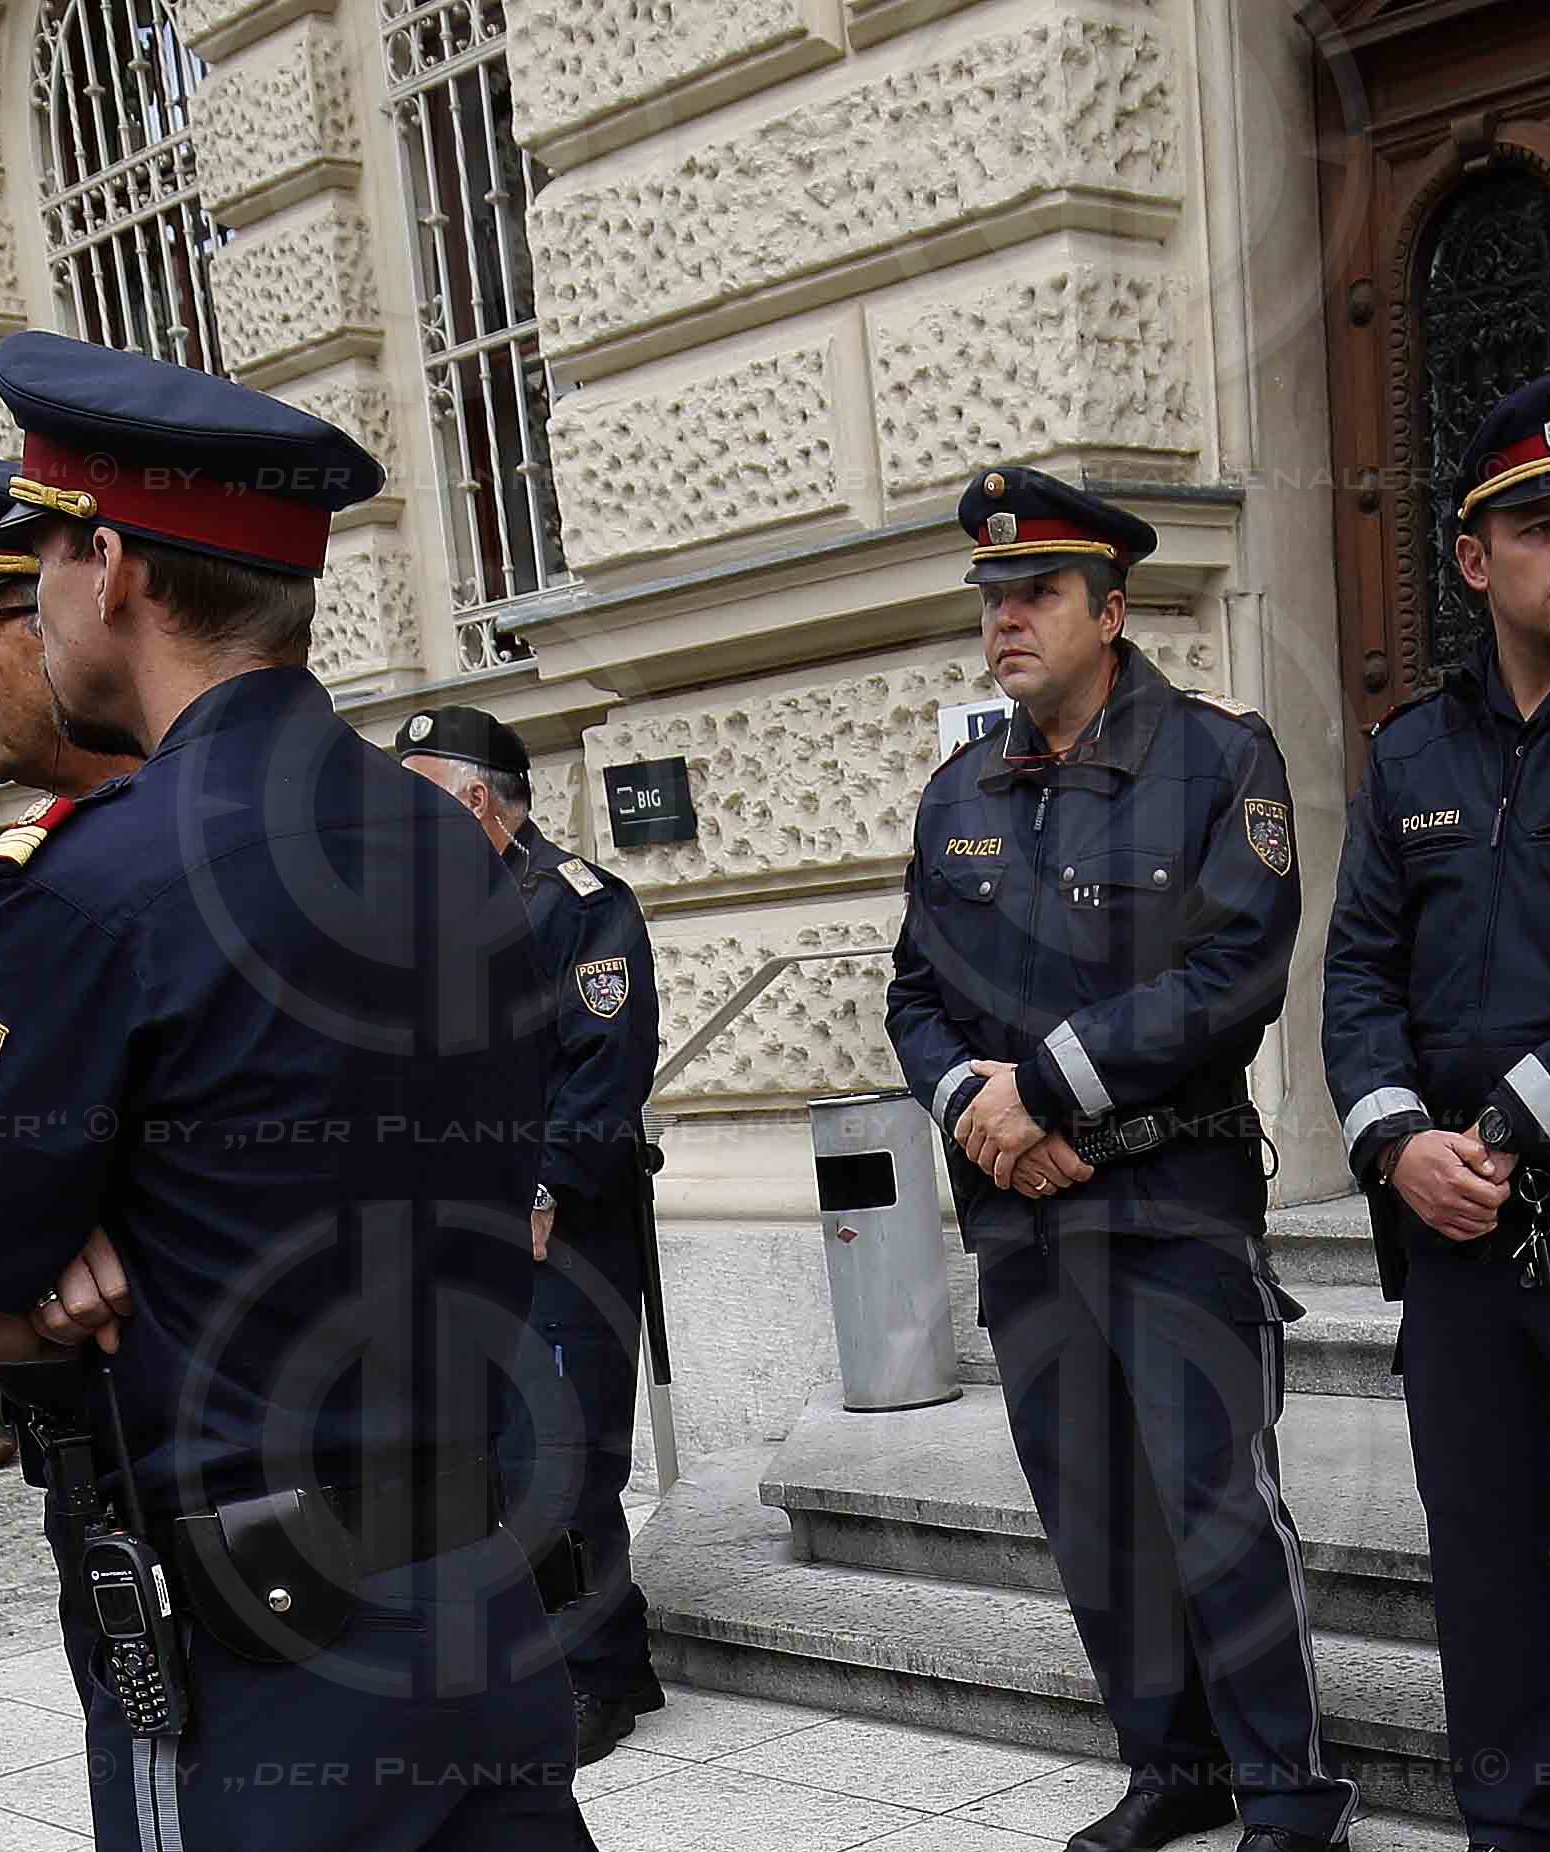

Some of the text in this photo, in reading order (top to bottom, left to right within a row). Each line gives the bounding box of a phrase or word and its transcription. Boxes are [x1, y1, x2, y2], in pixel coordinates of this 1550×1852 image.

[637, 788, 661, 809] BIG
[1248, 802, 1285, 820] POLIZE
[1403, 809, 1460, 834] POLIZEI
[945, 837, 1002, 856] POLIZEI
[579, 960, 623, 977] POLIZEI
